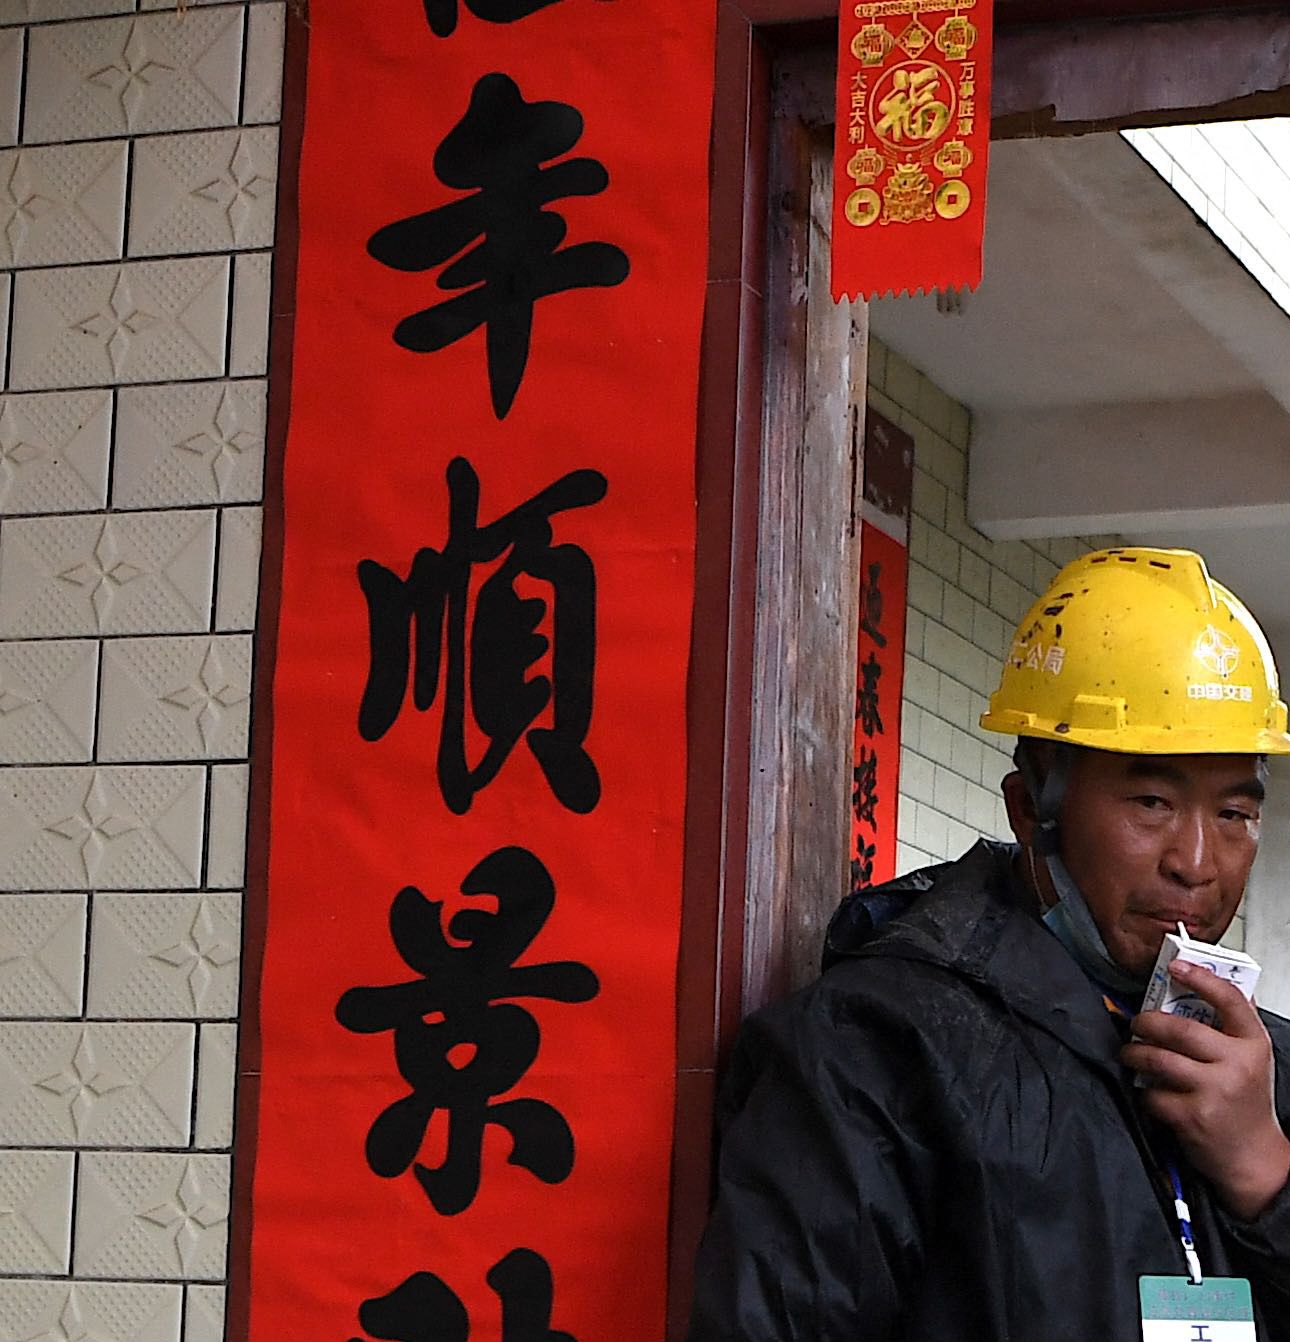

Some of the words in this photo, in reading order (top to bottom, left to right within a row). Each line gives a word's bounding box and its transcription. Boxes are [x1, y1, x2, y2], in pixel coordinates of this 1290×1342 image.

[848, 71, 867, 144] 大吉大利
[874, 66, 949, 142] 福
[956, 61, 976, 136] 万事胜意
